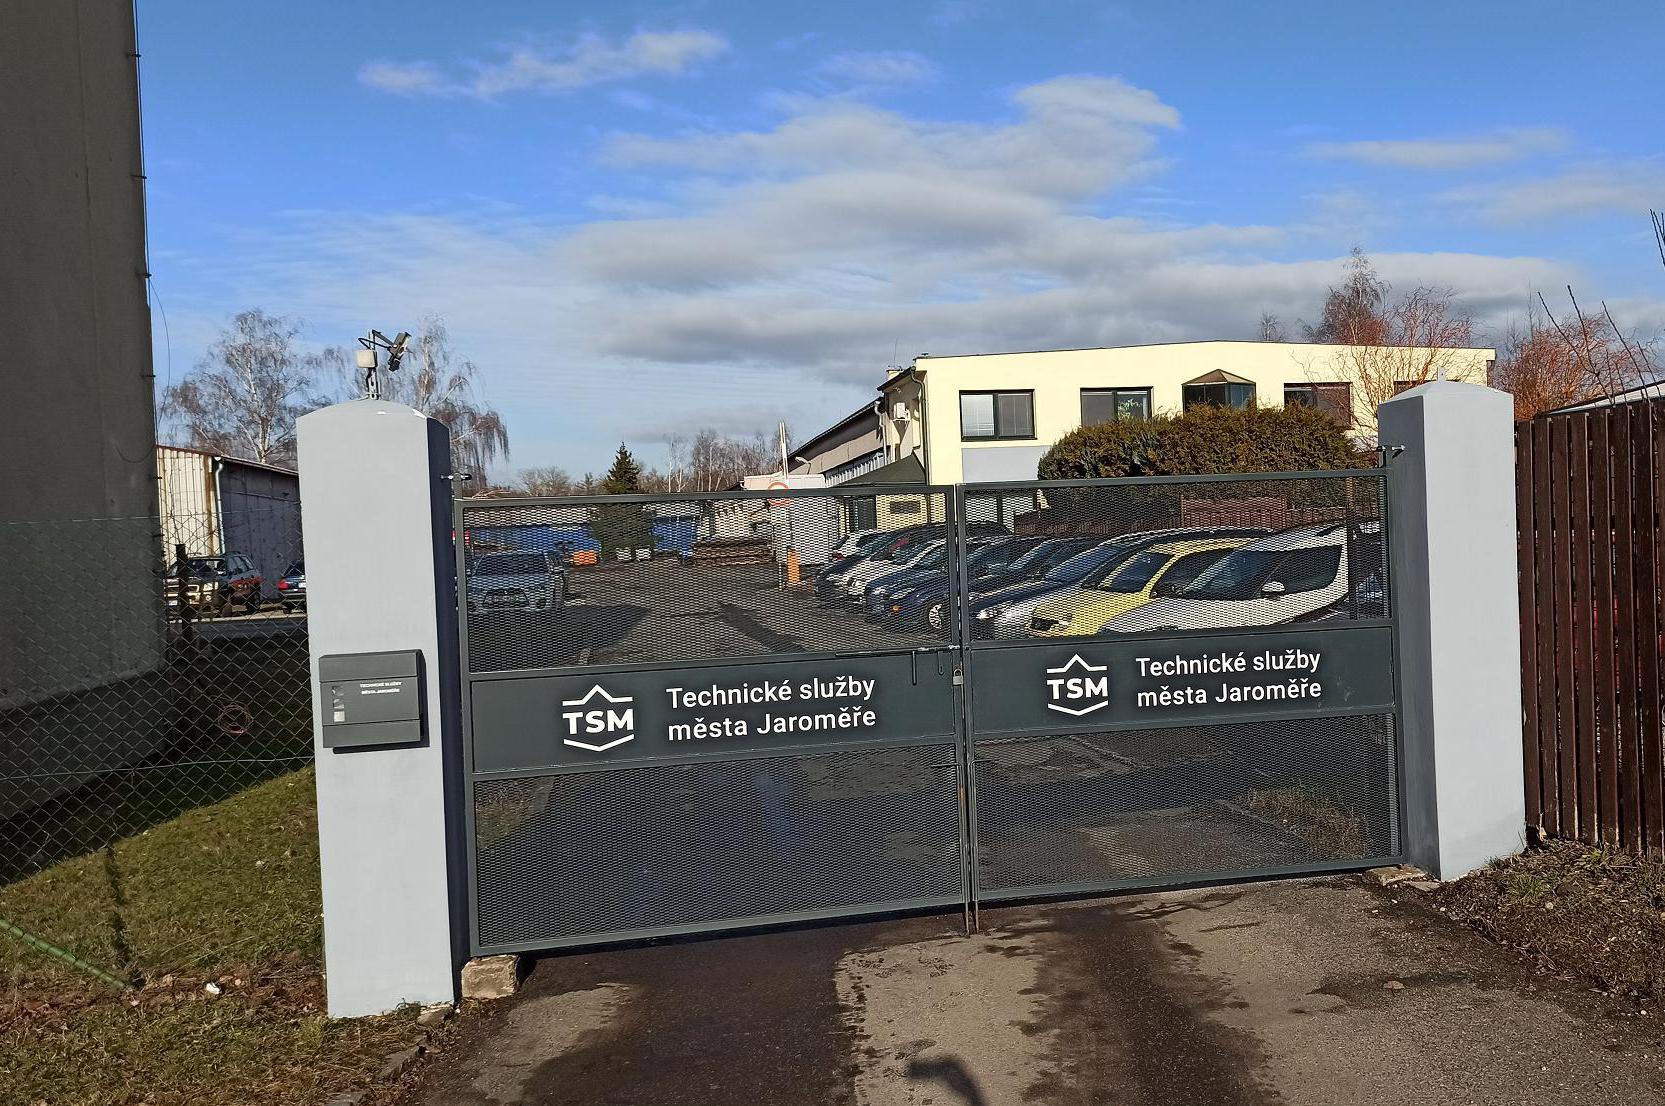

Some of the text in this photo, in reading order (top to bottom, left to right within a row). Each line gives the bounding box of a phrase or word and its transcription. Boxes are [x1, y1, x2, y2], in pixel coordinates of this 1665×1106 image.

[1135, 648, 1321, 677] Technické služby
[665, 675, 876, 709] Technické služby
[1046, 676, 1109, 700] TSM
[1137, 677, 1322, 707] města Jaroměře
[562, 708, 634, 735] TSM
[668, 705, 876, 741] města Jaroměře
